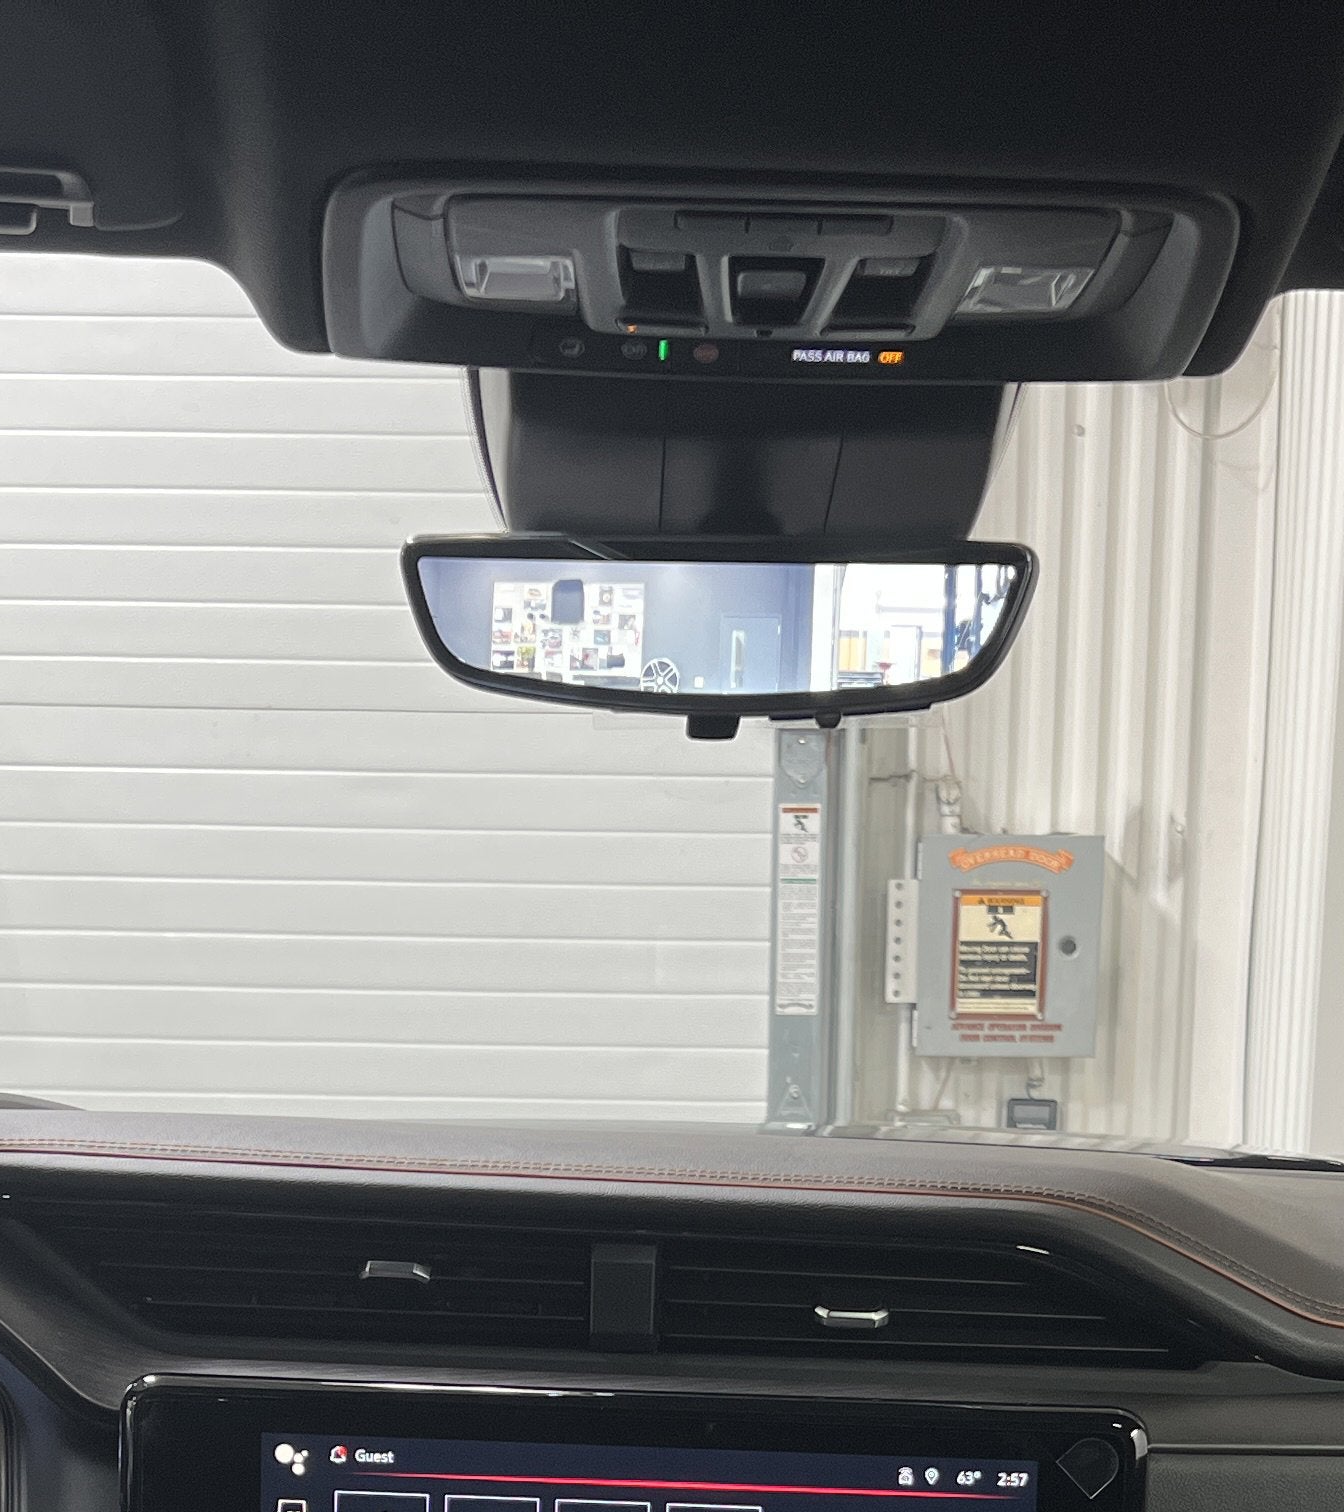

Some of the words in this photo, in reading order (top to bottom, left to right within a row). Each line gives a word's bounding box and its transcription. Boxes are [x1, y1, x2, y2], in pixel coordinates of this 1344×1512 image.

[792, 349, 822, 362] PASS
[824, 350, 844, 362] AIR
[846, 350, 871, 363] BAG
[878, 351, 904, 364] OFF
[354, 1448, 395, 1464] Guest
[996, 1471, 1029, 1487] 2:57
